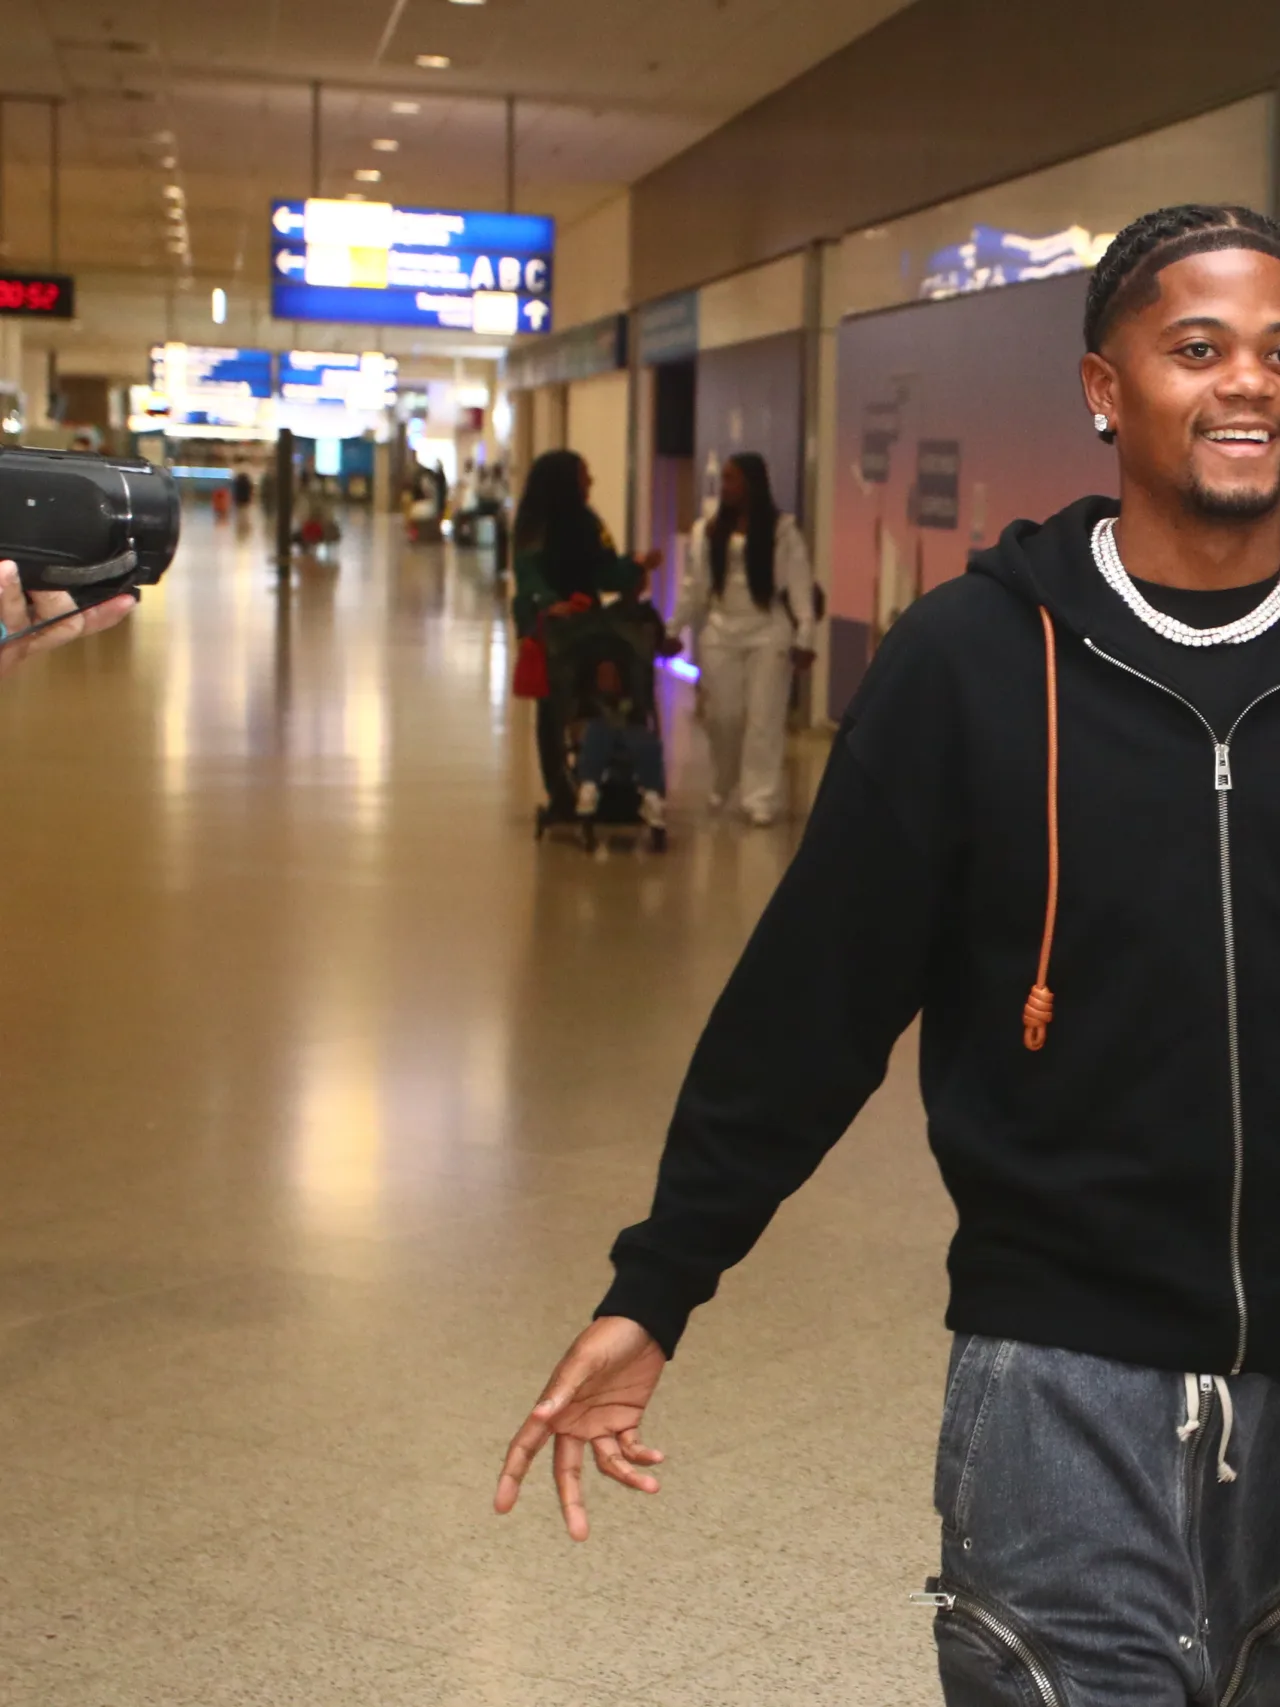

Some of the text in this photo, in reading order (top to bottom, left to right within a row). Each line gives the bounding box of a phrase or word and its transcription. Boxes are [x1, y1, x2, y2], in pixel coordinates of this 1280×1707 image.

[470, 255, 495, 290] A
[498, 257, 521, 291] B
[525, 259, 548, 292] C
